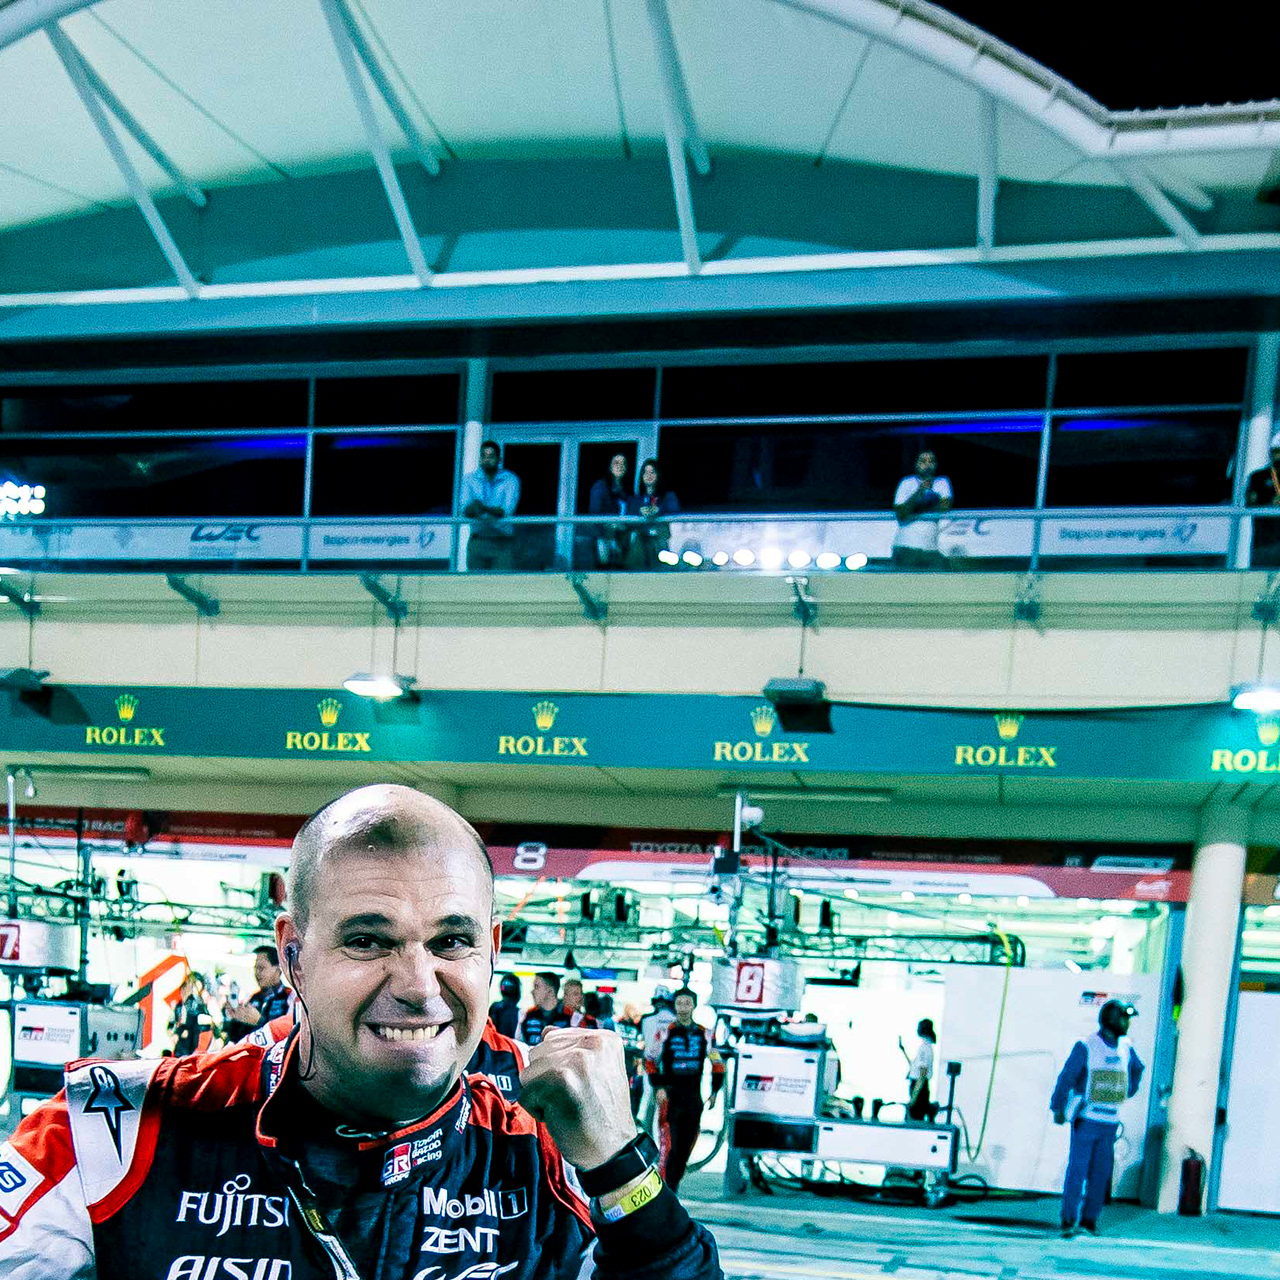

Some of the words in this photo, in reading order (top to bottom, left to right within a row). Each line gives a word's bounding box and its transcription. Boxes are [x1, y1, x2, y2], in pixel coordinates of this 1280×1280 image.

[85, 727, 165, 746] ROLEX
[285, 732, 370, 751] ROLEX
[498, 735, 588, 756] ROLEX
[713, 741, 809, 763] ROLEX
[954, 745, 1057, 768] ROLEX
[514, 842, 547, 870] 8
[0, 926, 18, 959] 7
[423, 1186, 498, 1218] Mobil
[420, 1226, 501, 1254] ZENT
